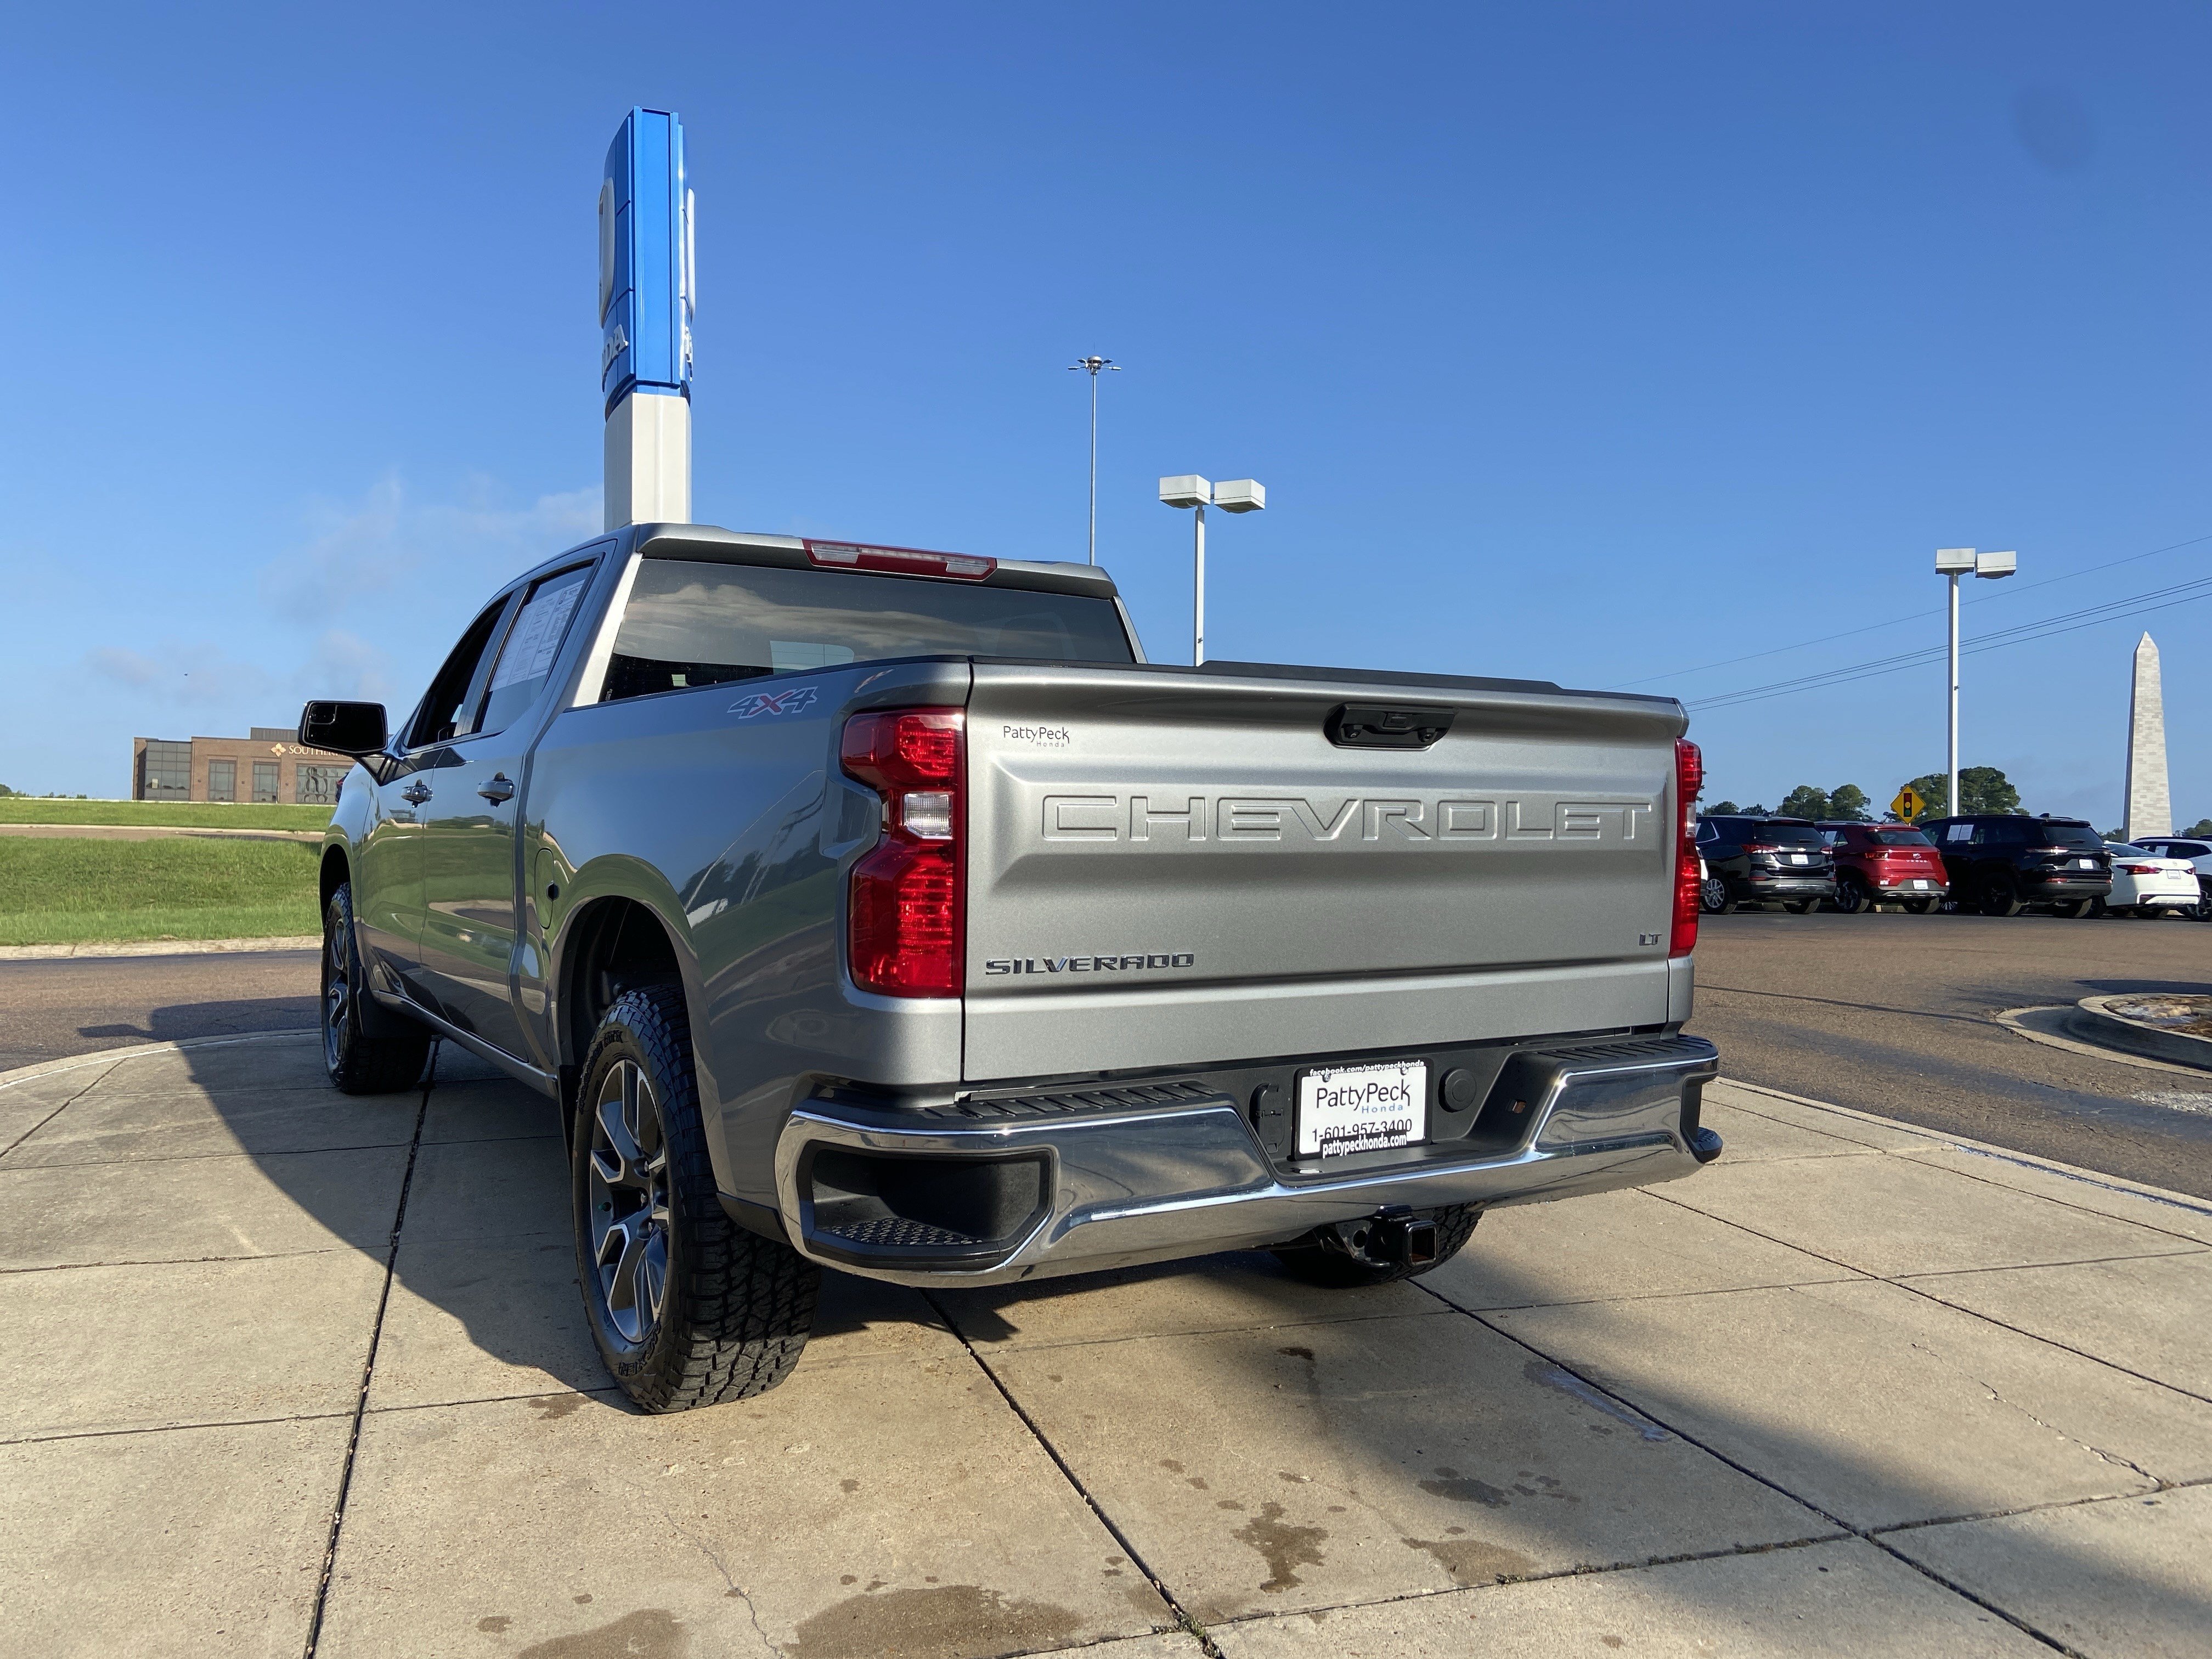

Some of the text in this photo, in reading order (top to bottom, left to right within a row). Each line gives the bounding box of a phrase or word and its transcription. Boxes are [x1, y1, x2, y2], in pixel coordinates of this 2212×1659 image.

[289, 745, 338, 756] SOUTH
[1042, 794, 1652, 842] CHEVROLET
[1639, 933, 1662, 946] LT
[986, 953, 1194, 975] SILVERADO
[1309, 1059, 1424, 1076] facebook.com/pattypeckhonda
[1362, 1103, 1403, 1114] Honda
[1312, 1119, 1412, 1142] 1-601-957-3400
[1322, 1133, 1407, 1159] pattypeckhonda.com
